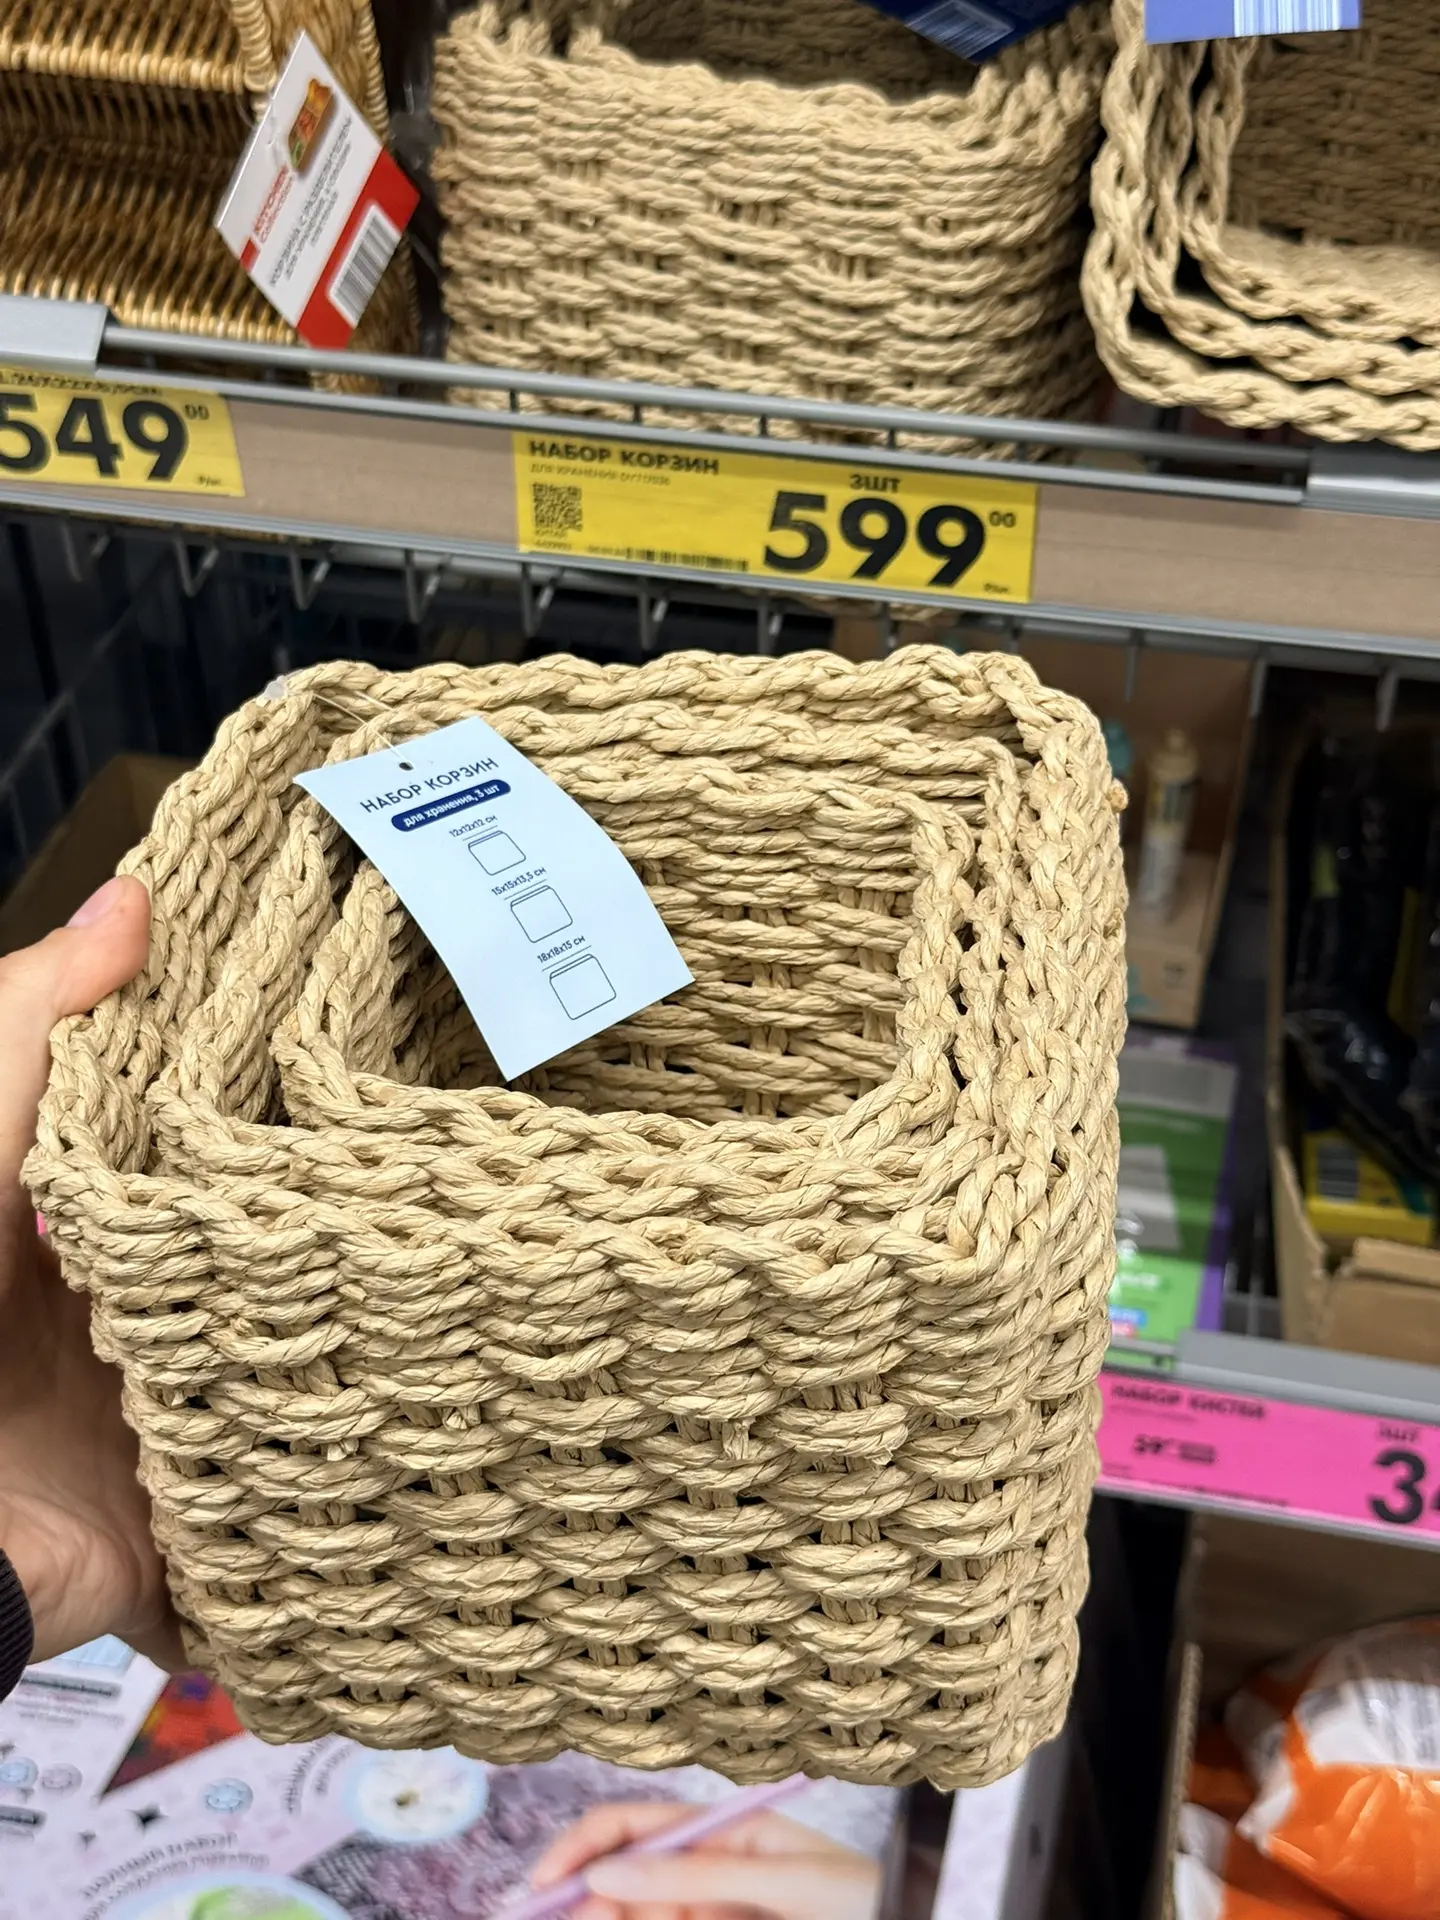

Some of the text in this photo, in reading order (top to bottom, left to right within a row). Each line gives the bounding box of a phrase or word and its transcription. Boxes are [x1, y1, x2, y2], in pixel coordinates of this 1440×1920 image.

[185, 404, 210, 421] 00
[0, 393, 190, 484] 549
[530, 440, 720, 475] НАБОР КОРЗИН
[763, 490, 986, 588] 599
[988, 510, 1017, 528] 00
[360, 757, 500, 813] НАБОР КОРЗИН
[403, 784, 501, 829] для хранения, 3 шт
[1369, 1448, 1440, 1525] 3
